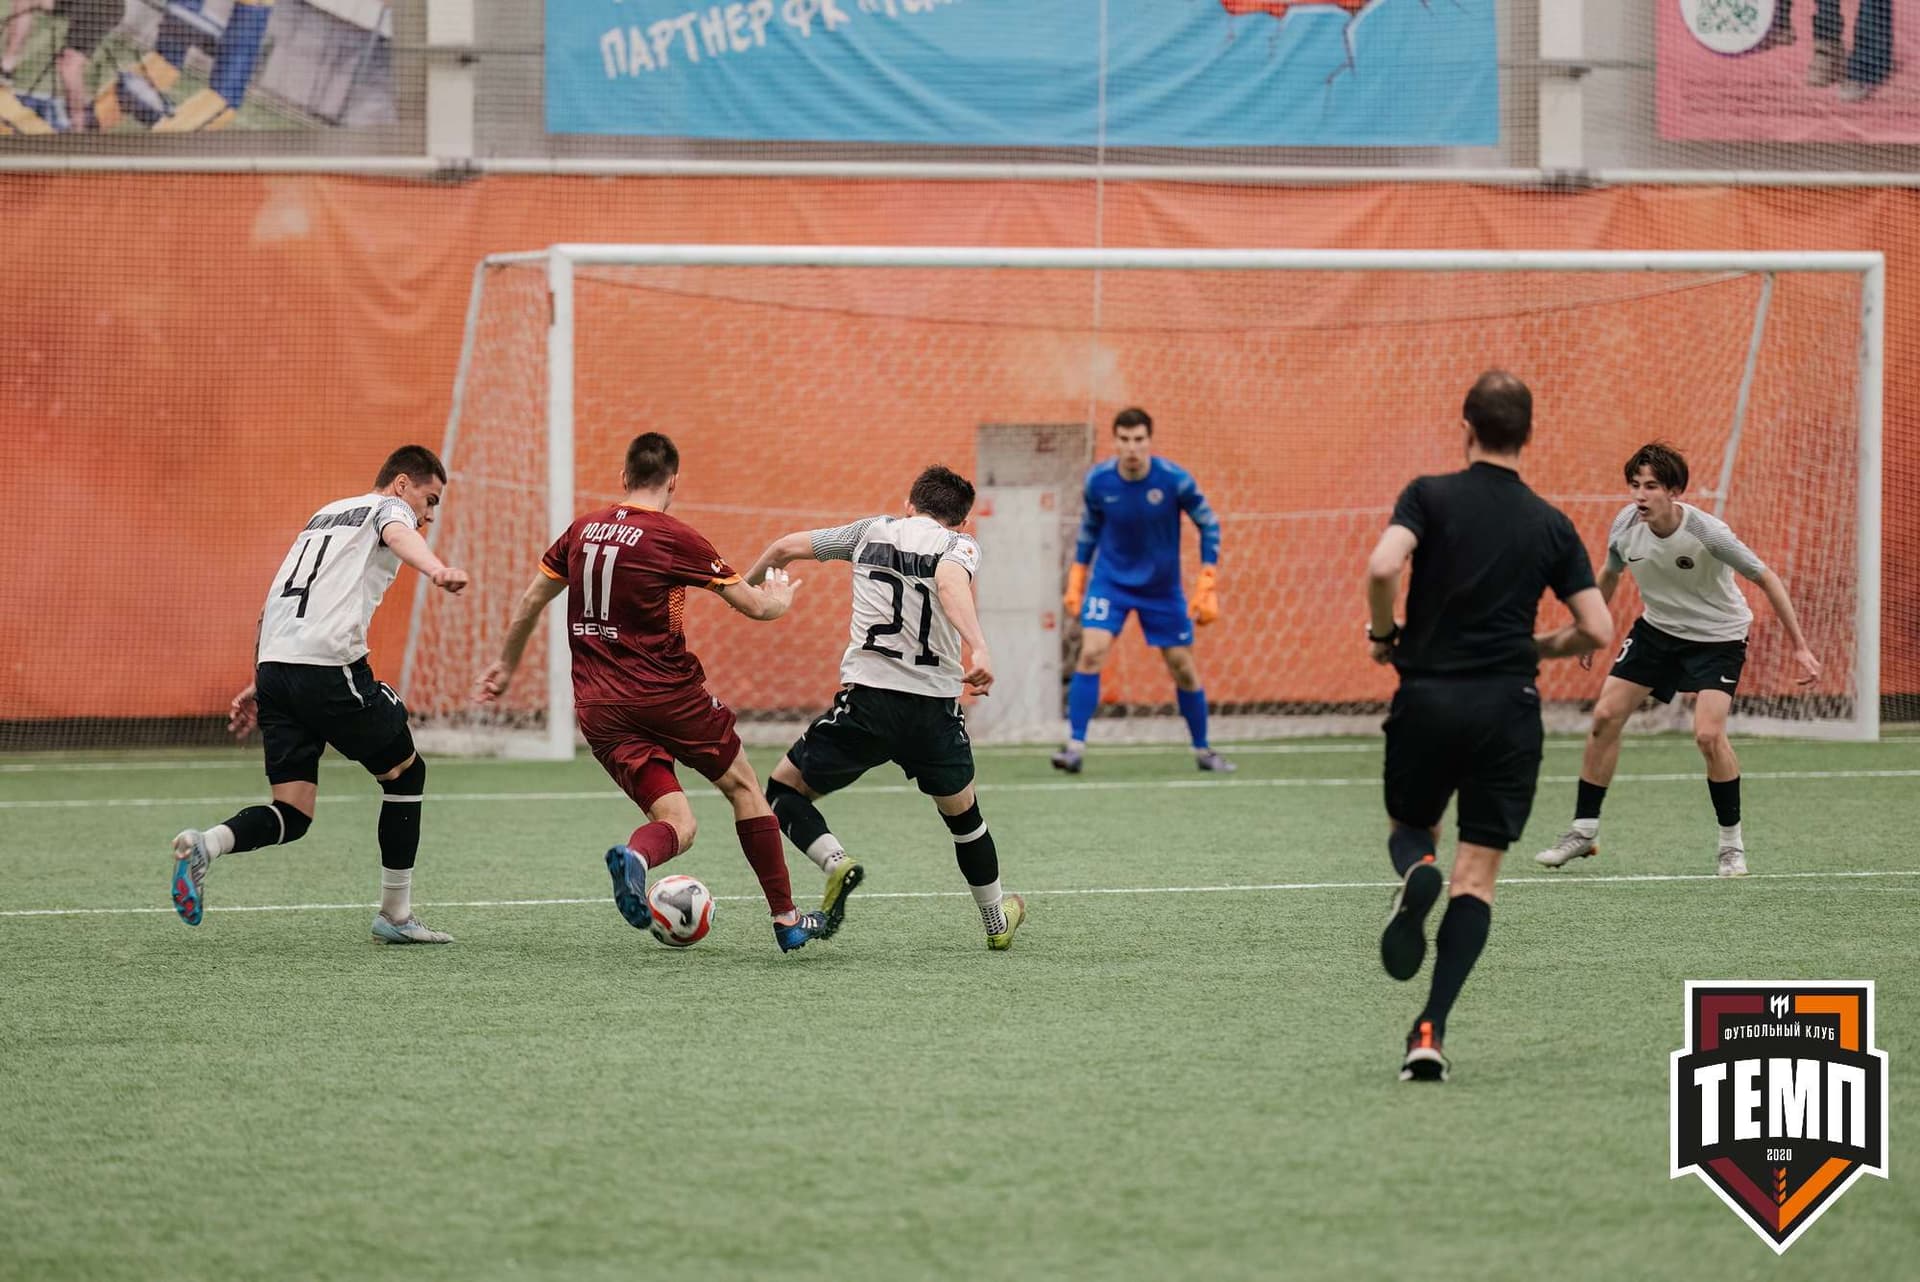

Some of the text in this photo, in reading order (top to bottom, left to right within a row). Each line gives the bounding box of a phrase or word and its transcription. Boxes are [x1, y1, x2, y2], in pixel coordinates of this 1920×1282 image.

[600, 1, 773, 79] ПАРТНЕР
[580, 522, 644, 547] РОДИЧЕВ
[280, 534, 333, 618] 4
[582, 543, 619, 621] 11
[862, 571, 940, 666] 21
